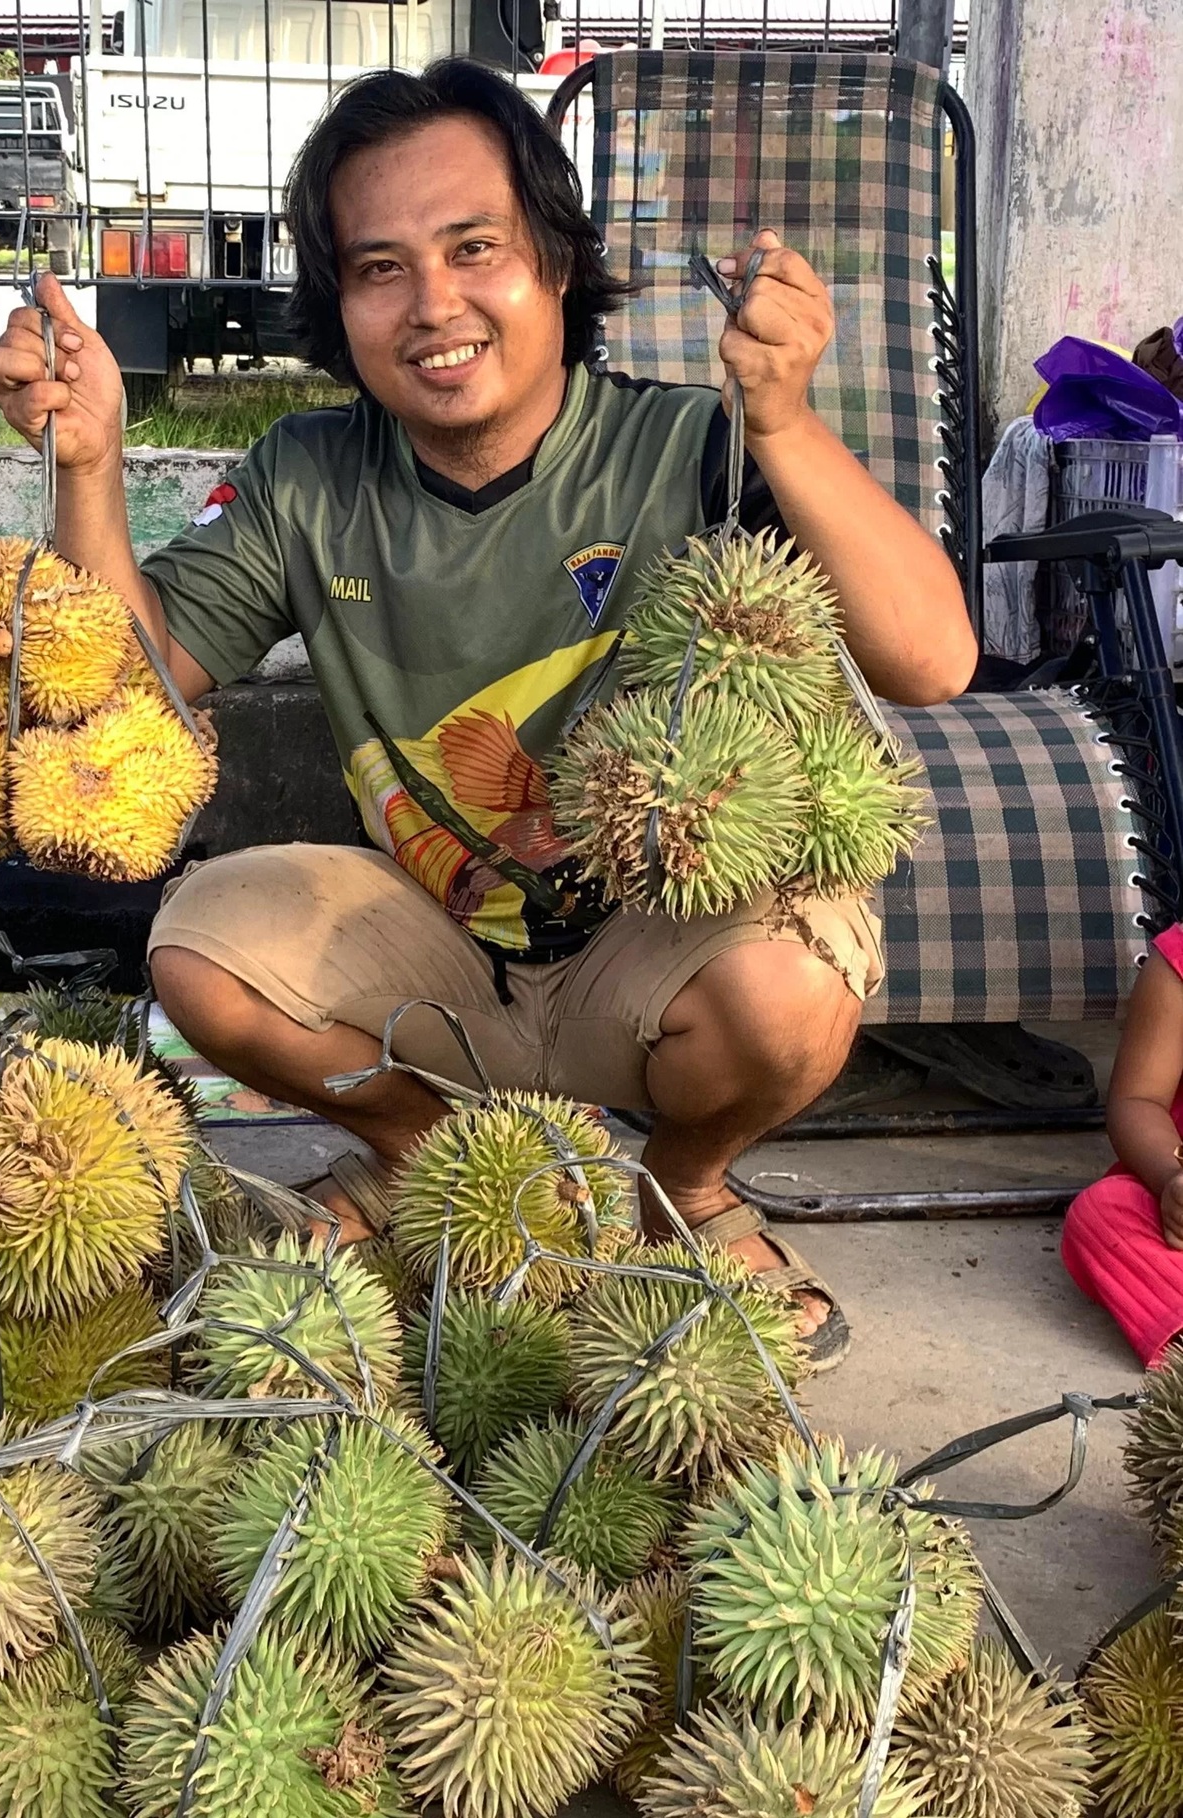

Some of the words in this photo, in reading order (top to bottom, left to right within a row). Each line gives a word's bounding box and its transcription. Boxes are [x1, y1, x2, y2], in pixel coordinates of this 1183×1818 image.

[110, 94, 185, 110] ISUZU
[265, 246, 294, 275] KU
[329, 575, 372, 602] MAIL
